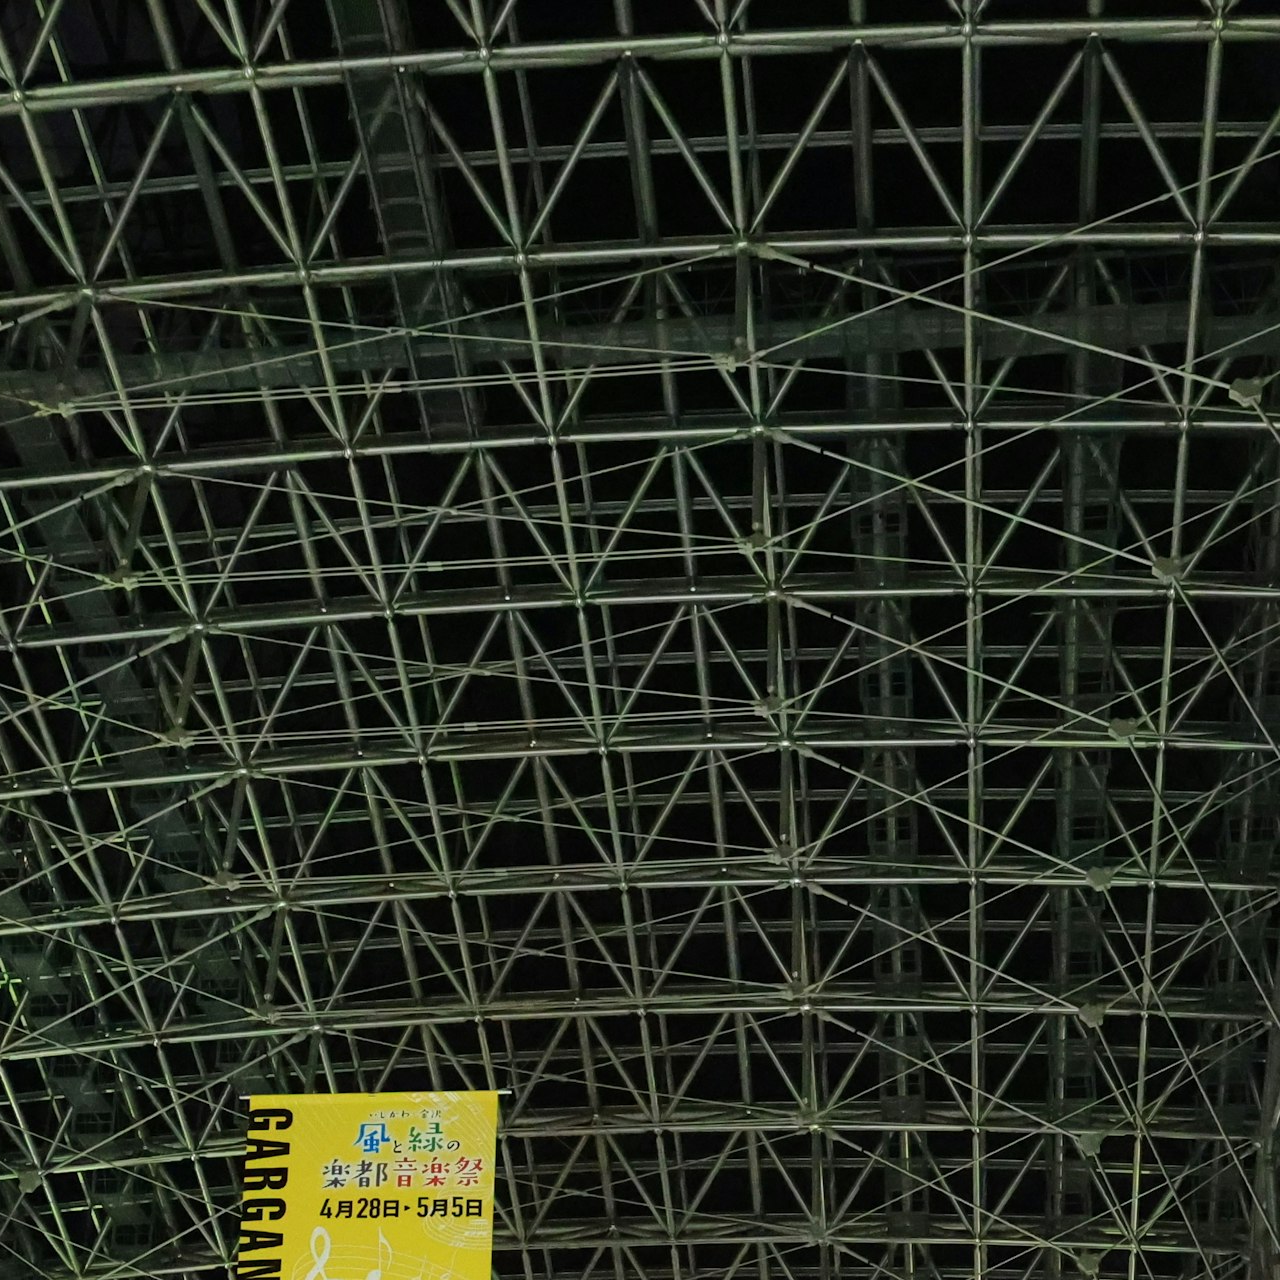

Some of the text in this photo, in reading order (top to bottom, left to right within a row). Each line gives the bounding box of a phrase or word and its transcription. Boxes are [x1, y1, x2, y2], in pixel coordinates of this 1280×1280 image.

[353, 1122, 461, 1154] 風と緑の
[322, 1156, 484, 1189] 楽都音楽祭
[319, 1197, 483, 1219] 4月28日 5月5日
